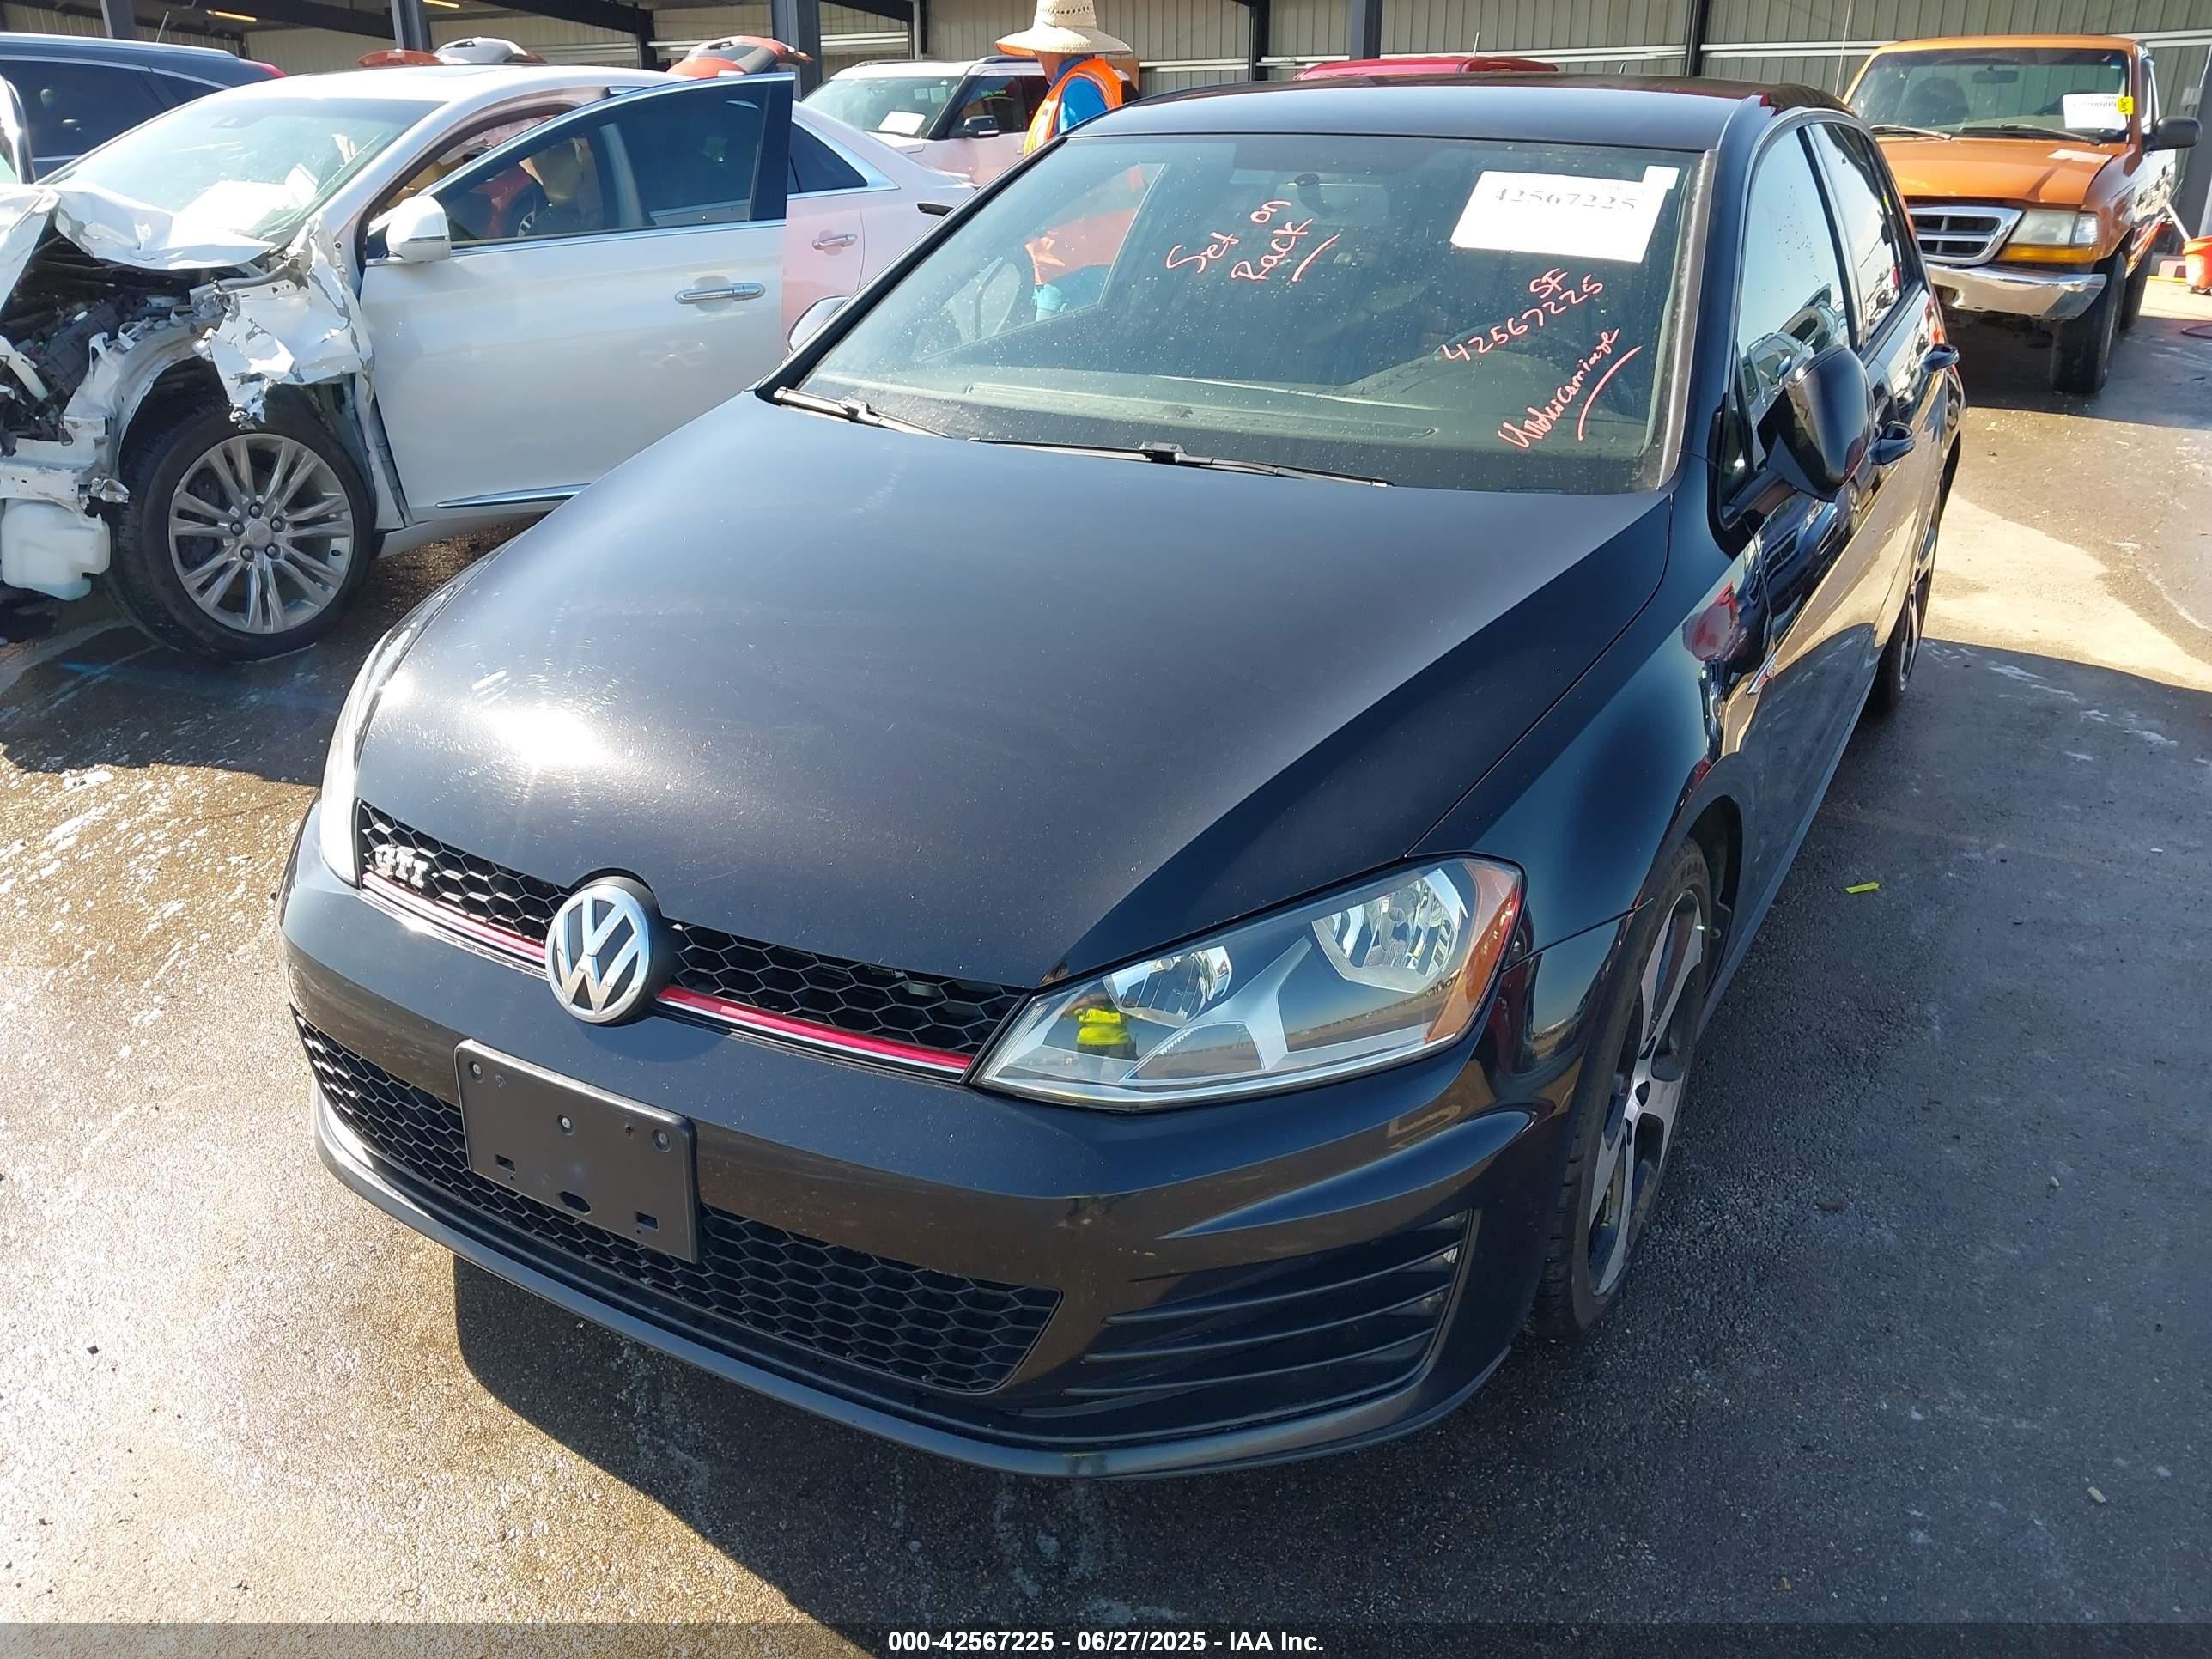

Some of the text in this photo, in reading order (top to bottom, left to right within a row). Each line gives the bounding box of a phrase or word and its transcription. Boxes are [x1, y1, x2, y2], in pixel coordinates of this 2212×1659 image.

[1495, 187, 1638, 210] 42567225
[1165, 199, 1292, 275] Set on
[1230, 217, 1314, 280] Rack
[1441, 273, 1604, 362] 42567225
